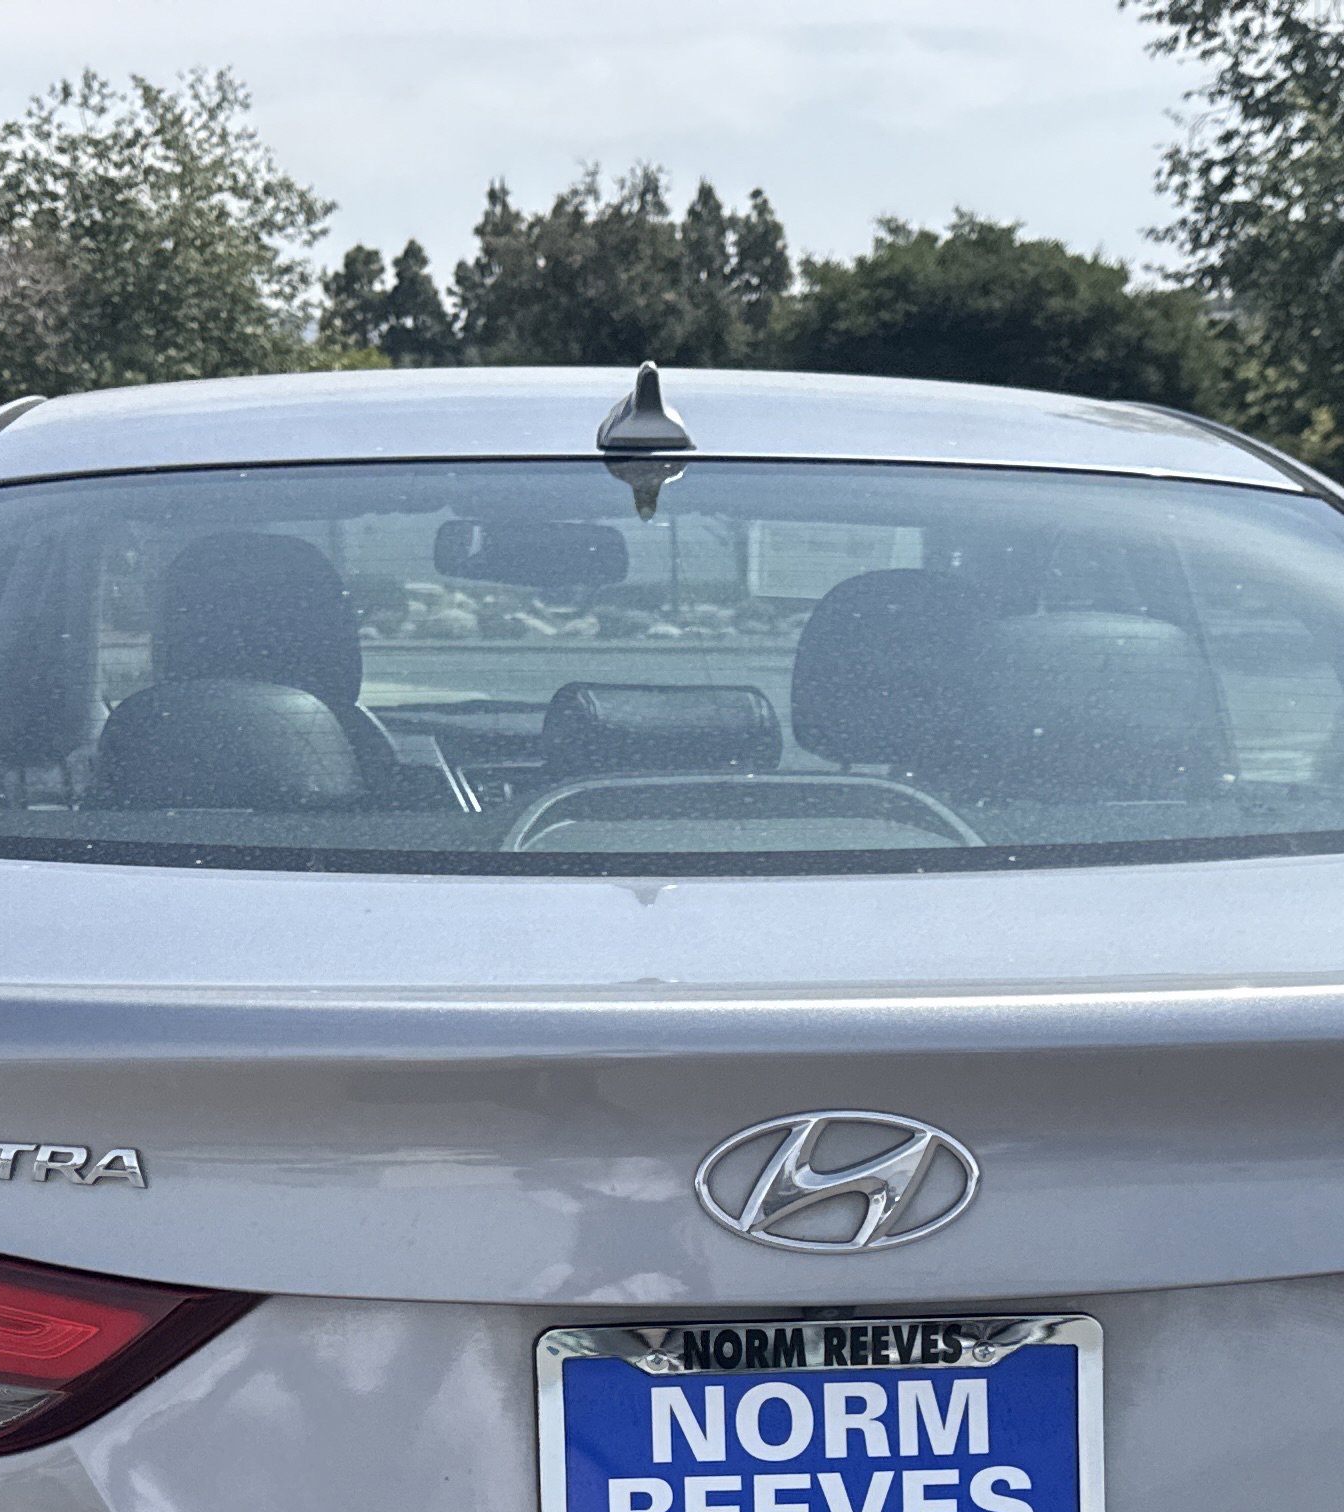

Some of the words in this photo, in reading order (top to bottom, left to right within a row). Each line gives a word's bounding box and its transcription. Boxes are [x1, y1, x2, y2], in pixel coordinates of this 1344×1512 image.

[682, 1327, 807, 1371] NORM
[823, 1324, 963, 1367] REEVES
[650, 1378, 990, 1464] NORM
